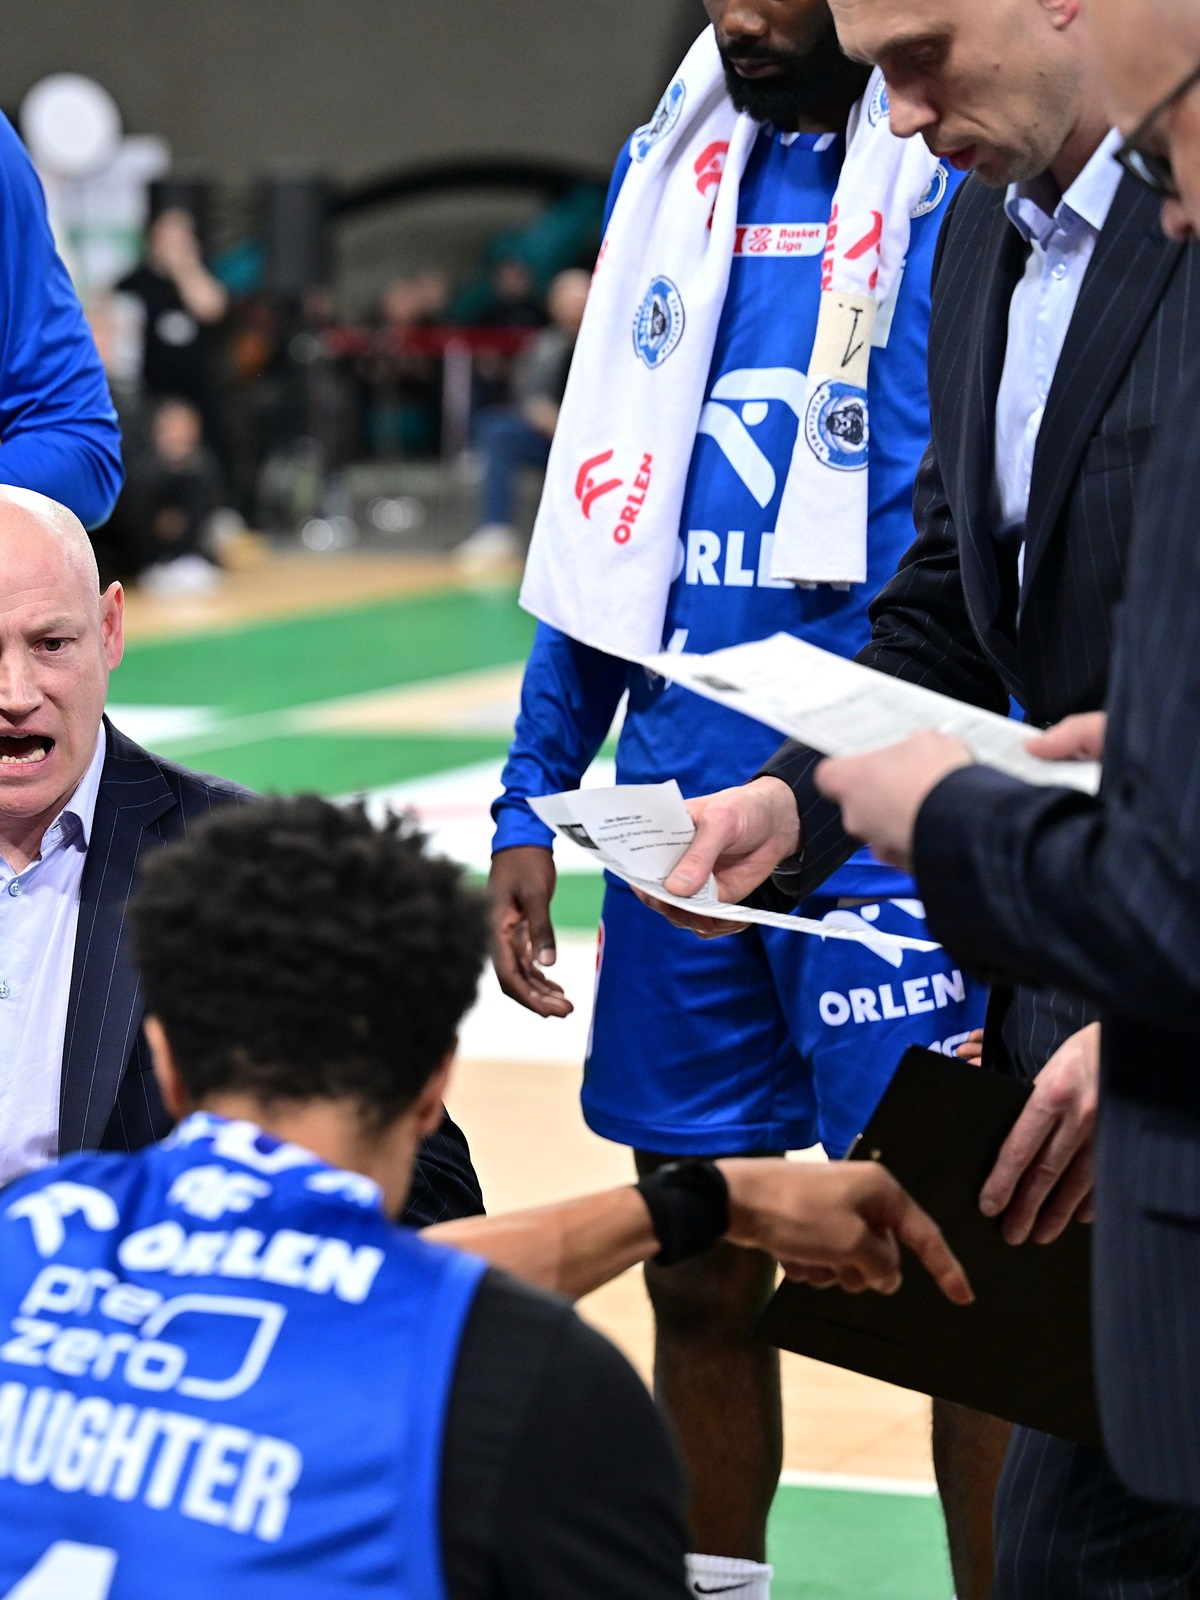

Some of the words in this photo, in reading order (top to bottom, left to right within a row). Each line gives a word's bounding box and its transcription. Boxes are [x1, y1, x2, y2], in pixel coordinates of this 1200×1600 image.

[776, 241, 803, 254] Liga
[779, 227, 821, 239] Basket
[613, 452, 653, 545] ORLEN
[671, 529, 851, 592] RLE
[819, 969, 967, 1027] ORLEN
[118, 1219, 386, 1304] ORLEN
[19, 1264, 164, 1326] pre
